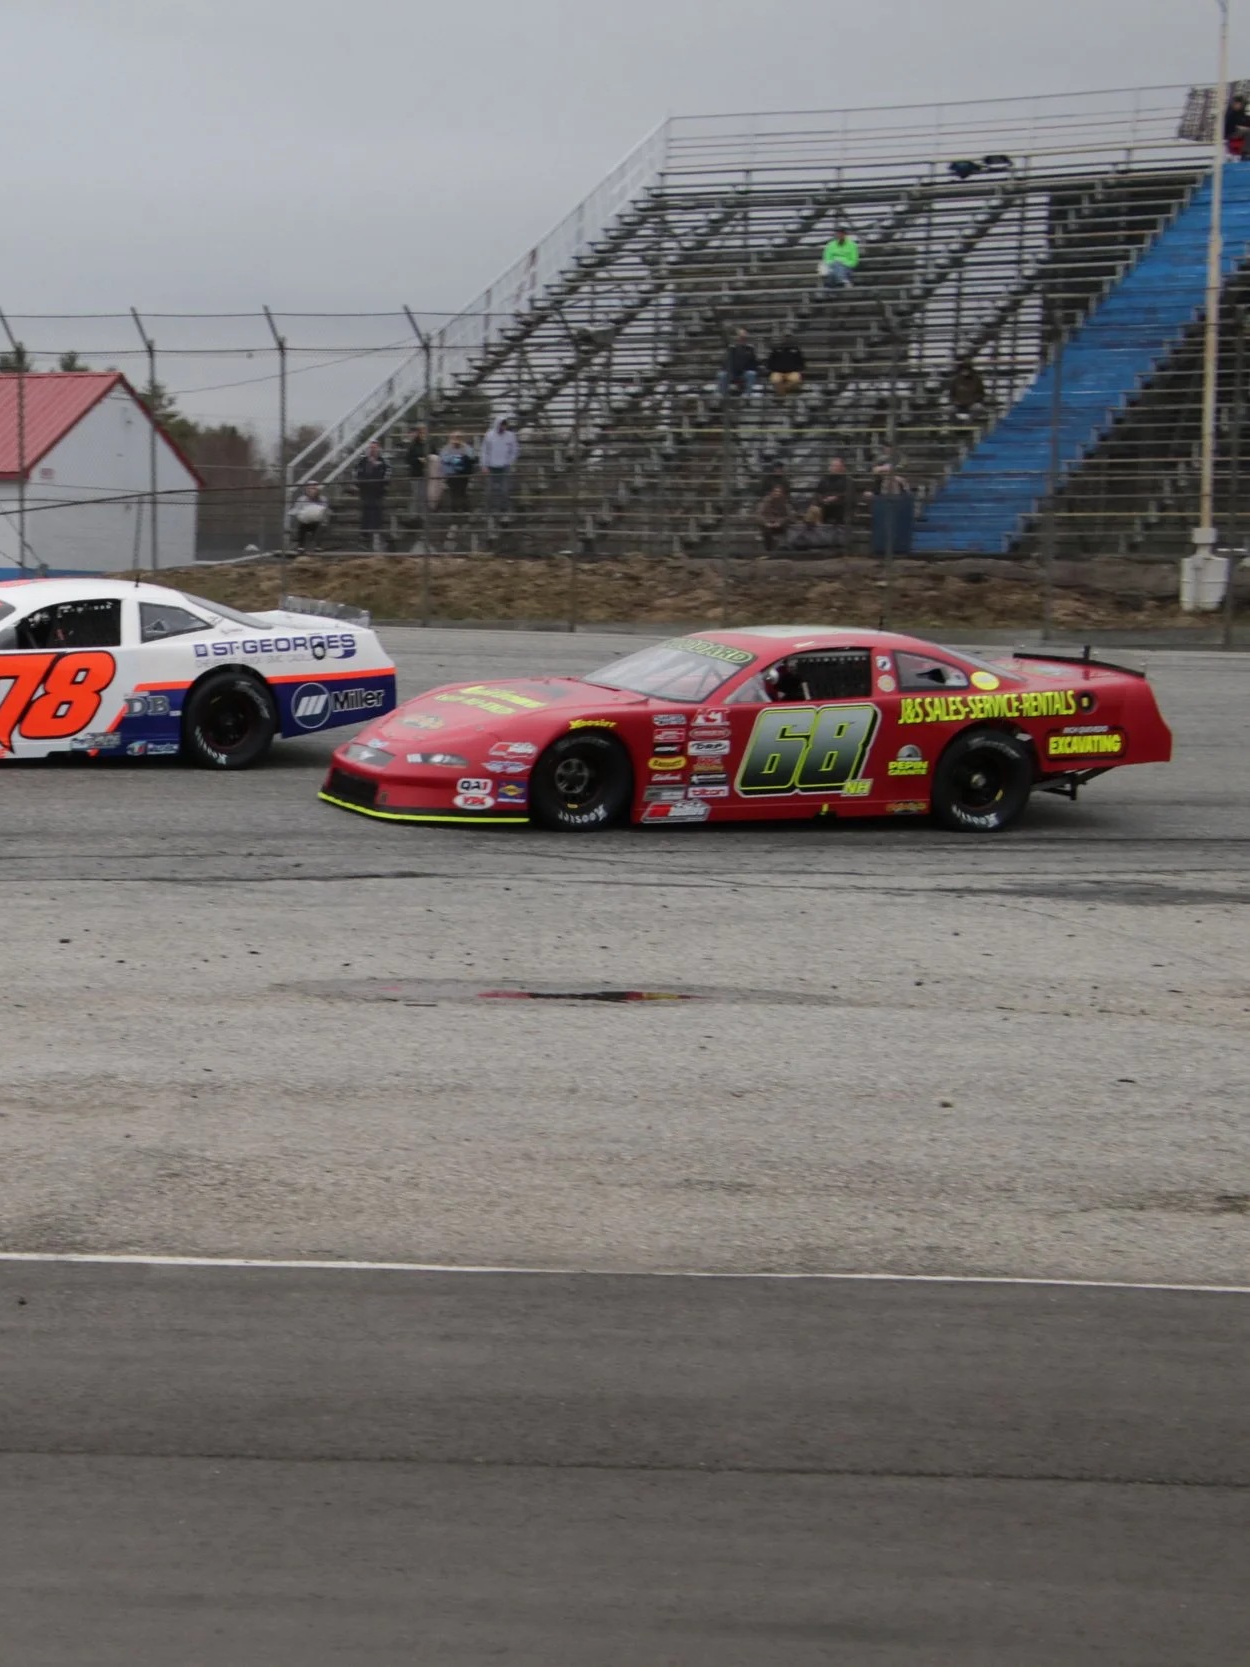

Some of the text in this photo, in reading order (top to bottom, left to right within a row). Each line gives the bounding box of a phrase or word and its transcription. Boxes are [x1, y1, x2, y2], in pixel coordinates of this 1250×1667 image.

[332, 688, 385, 713] Miller
[898, 698, 924, 724] J&S
[733, 702, 882, 797] 68
[1048, 734, 1122, 754] EXCAVATING
[459, 780, 488, 791] QA1
[844, 780, 873, 794] NH
